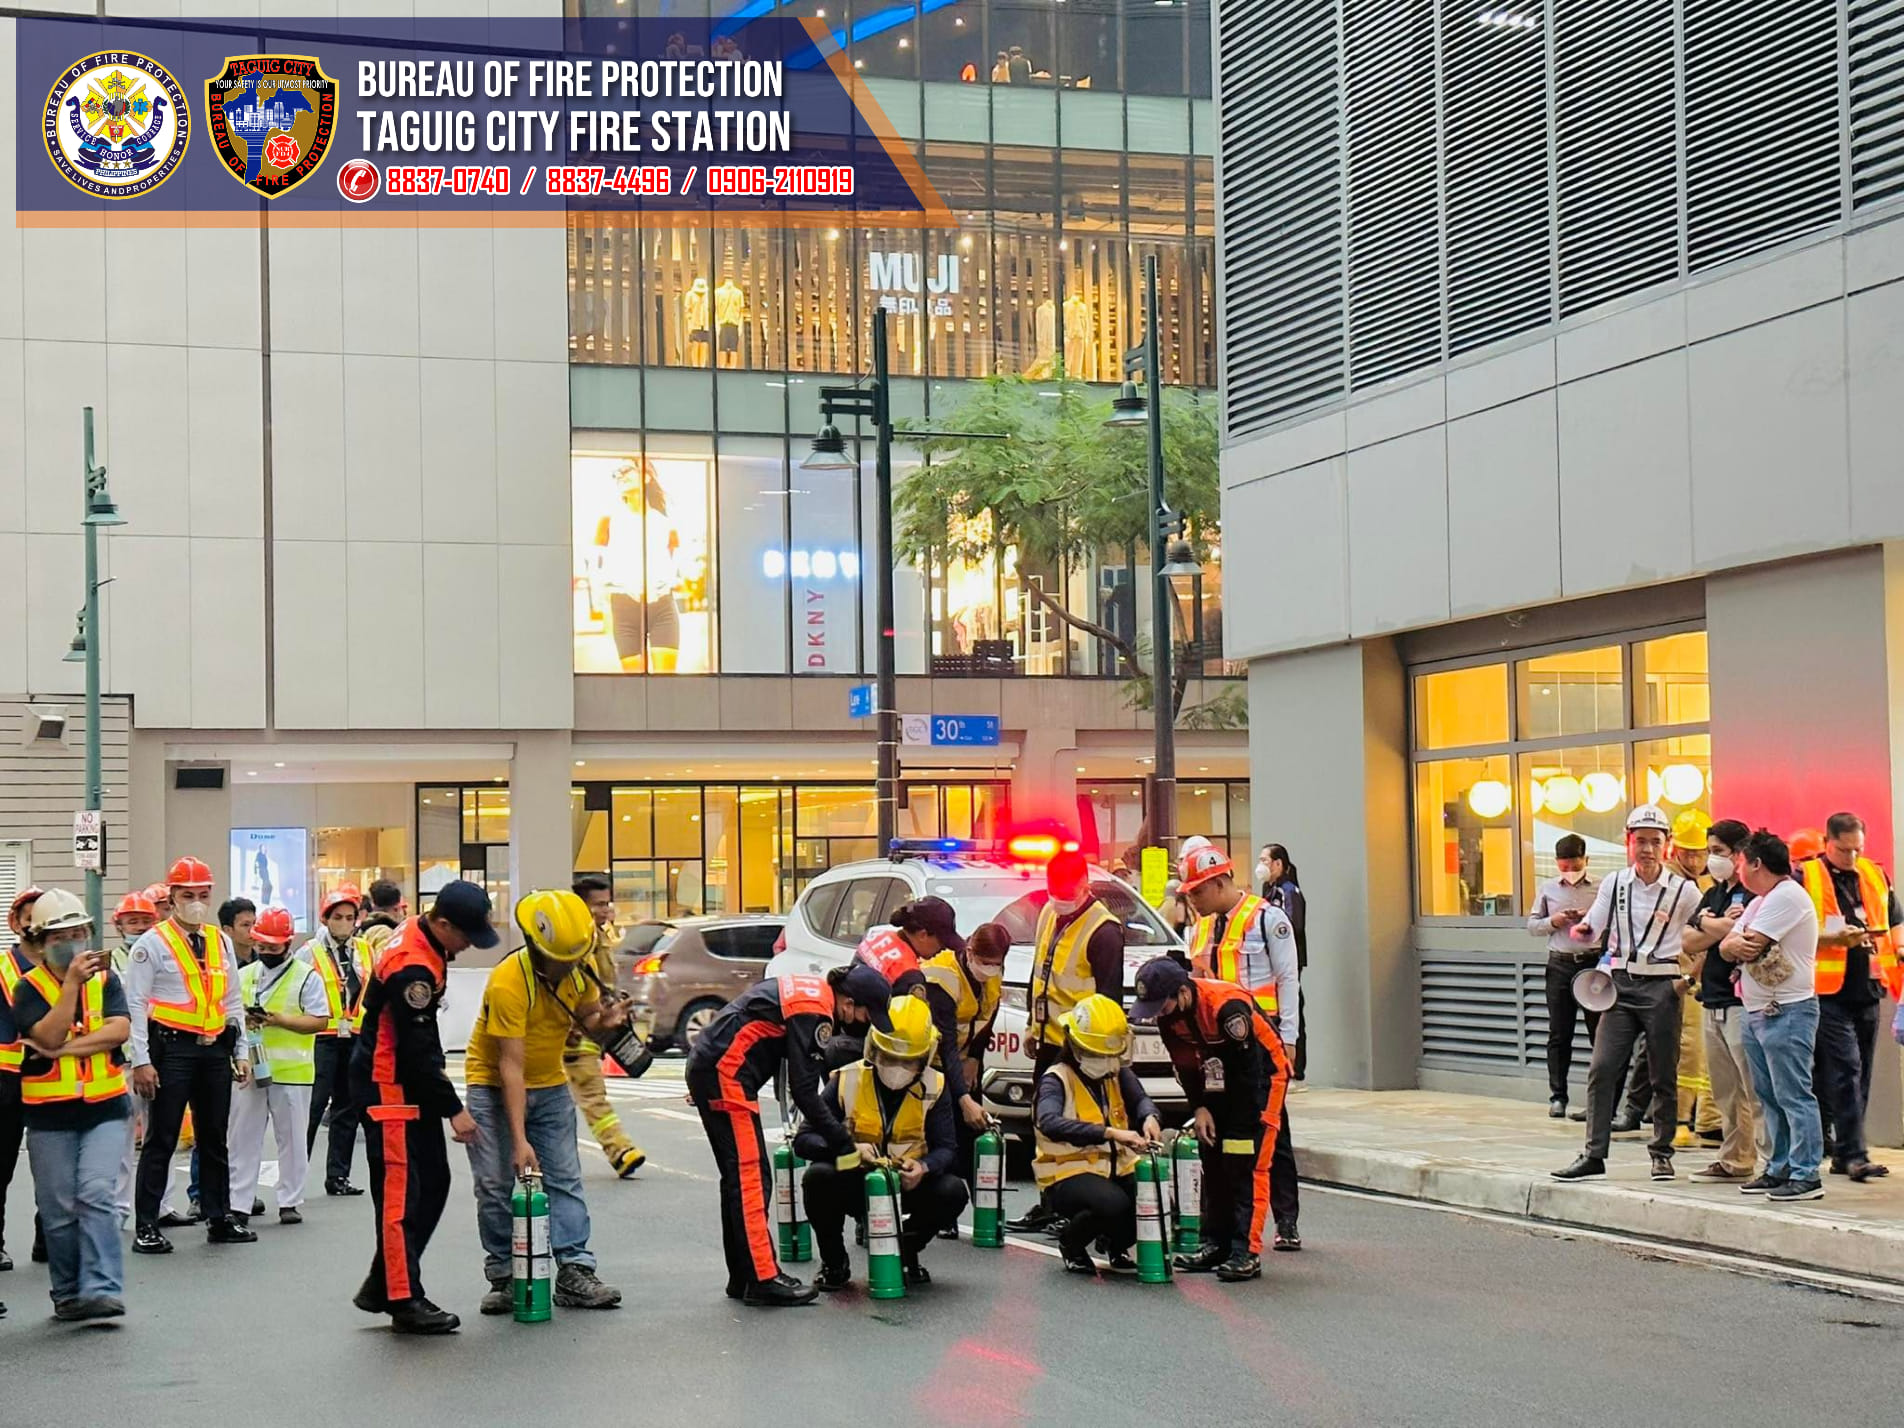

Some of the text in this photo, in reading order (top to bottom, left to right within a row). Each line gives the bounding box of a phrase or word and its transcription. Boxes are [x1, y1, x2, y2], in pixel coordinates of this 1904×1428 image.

[869, 251, 960, 294] MUJI
[879, 295, 953, 316] 無印品
[807, 588, 826, 667] DKNY
[81, 812, 94, 824] NO
